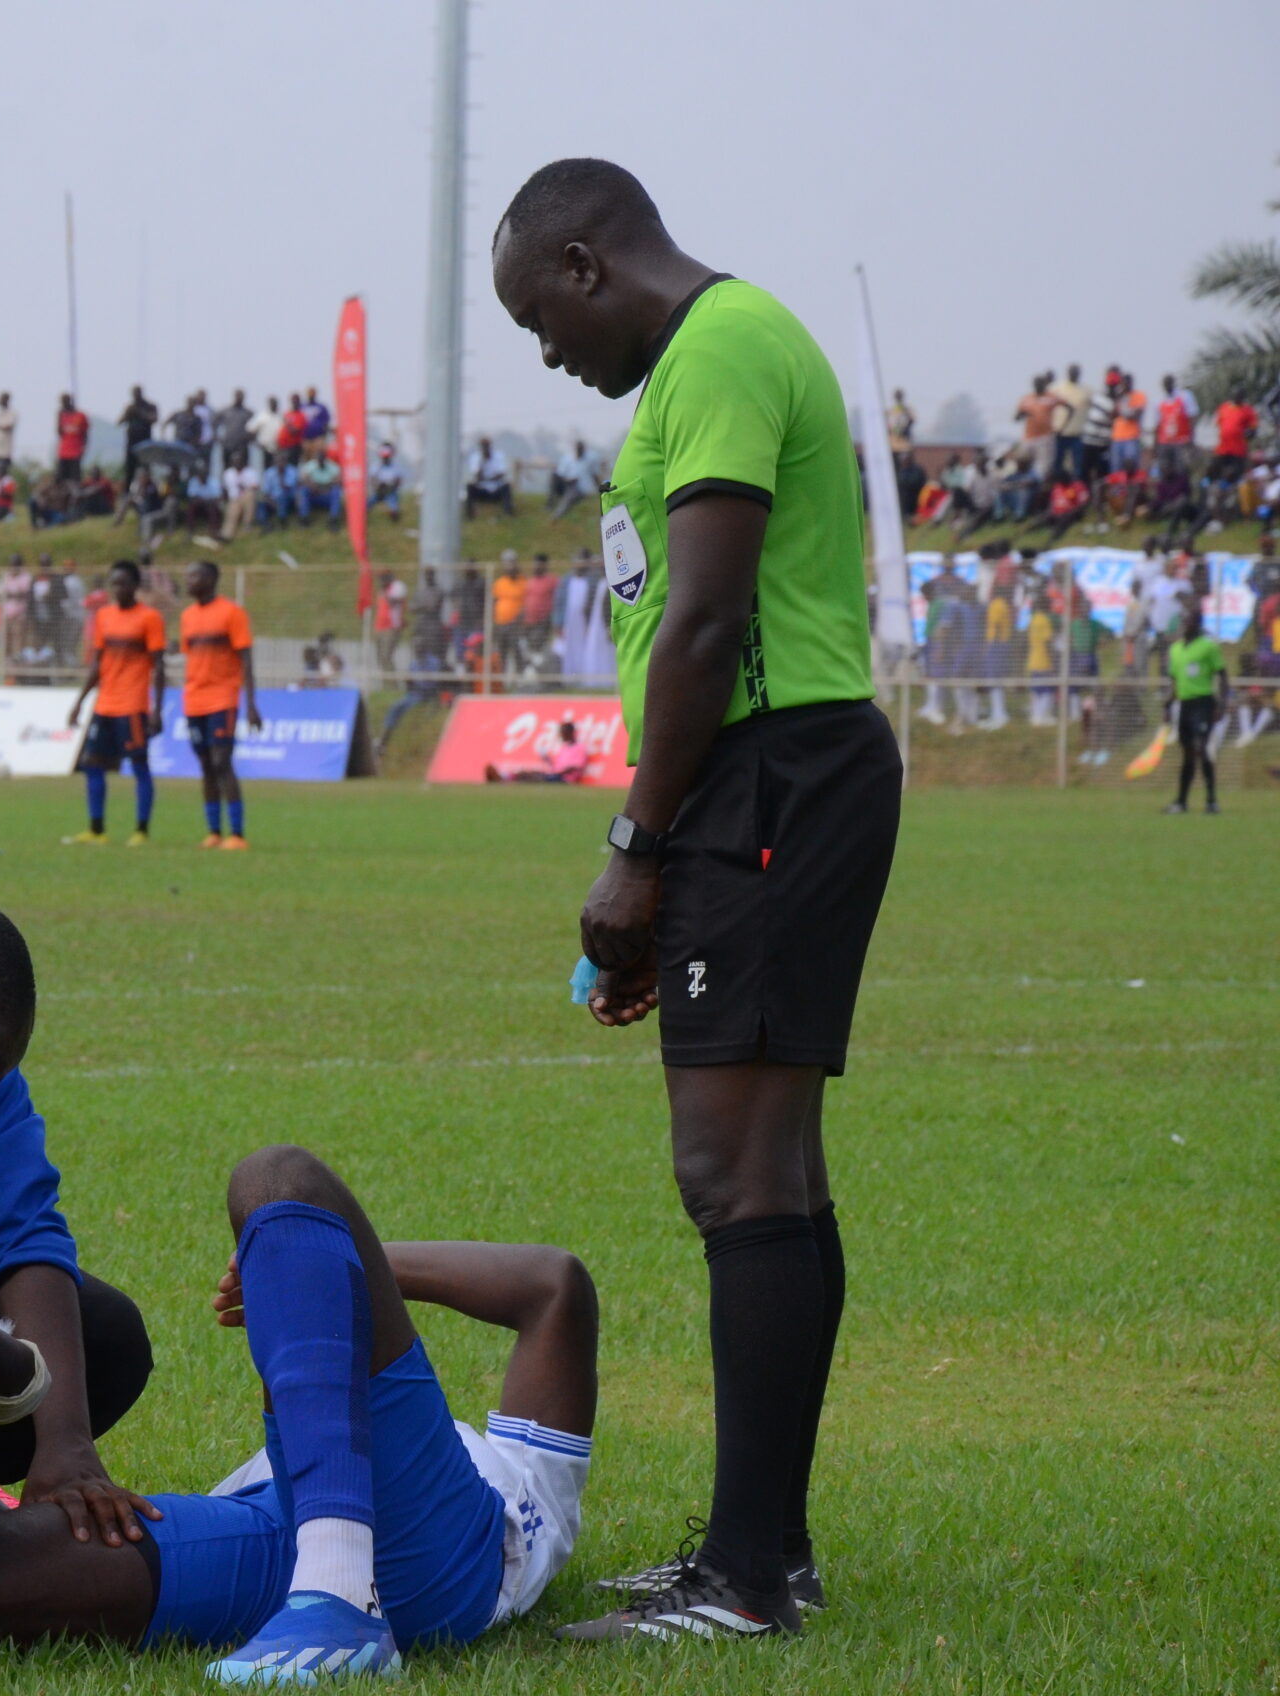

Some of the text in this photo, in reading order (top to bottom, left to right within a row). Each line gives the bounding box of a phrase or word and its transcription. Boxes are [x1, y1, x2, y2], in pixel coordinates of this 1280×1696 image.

[605, 519, 627, 540] REFEREE
[621, 581, 637, 596] 2026
[534, 709, 621, 755] atel
